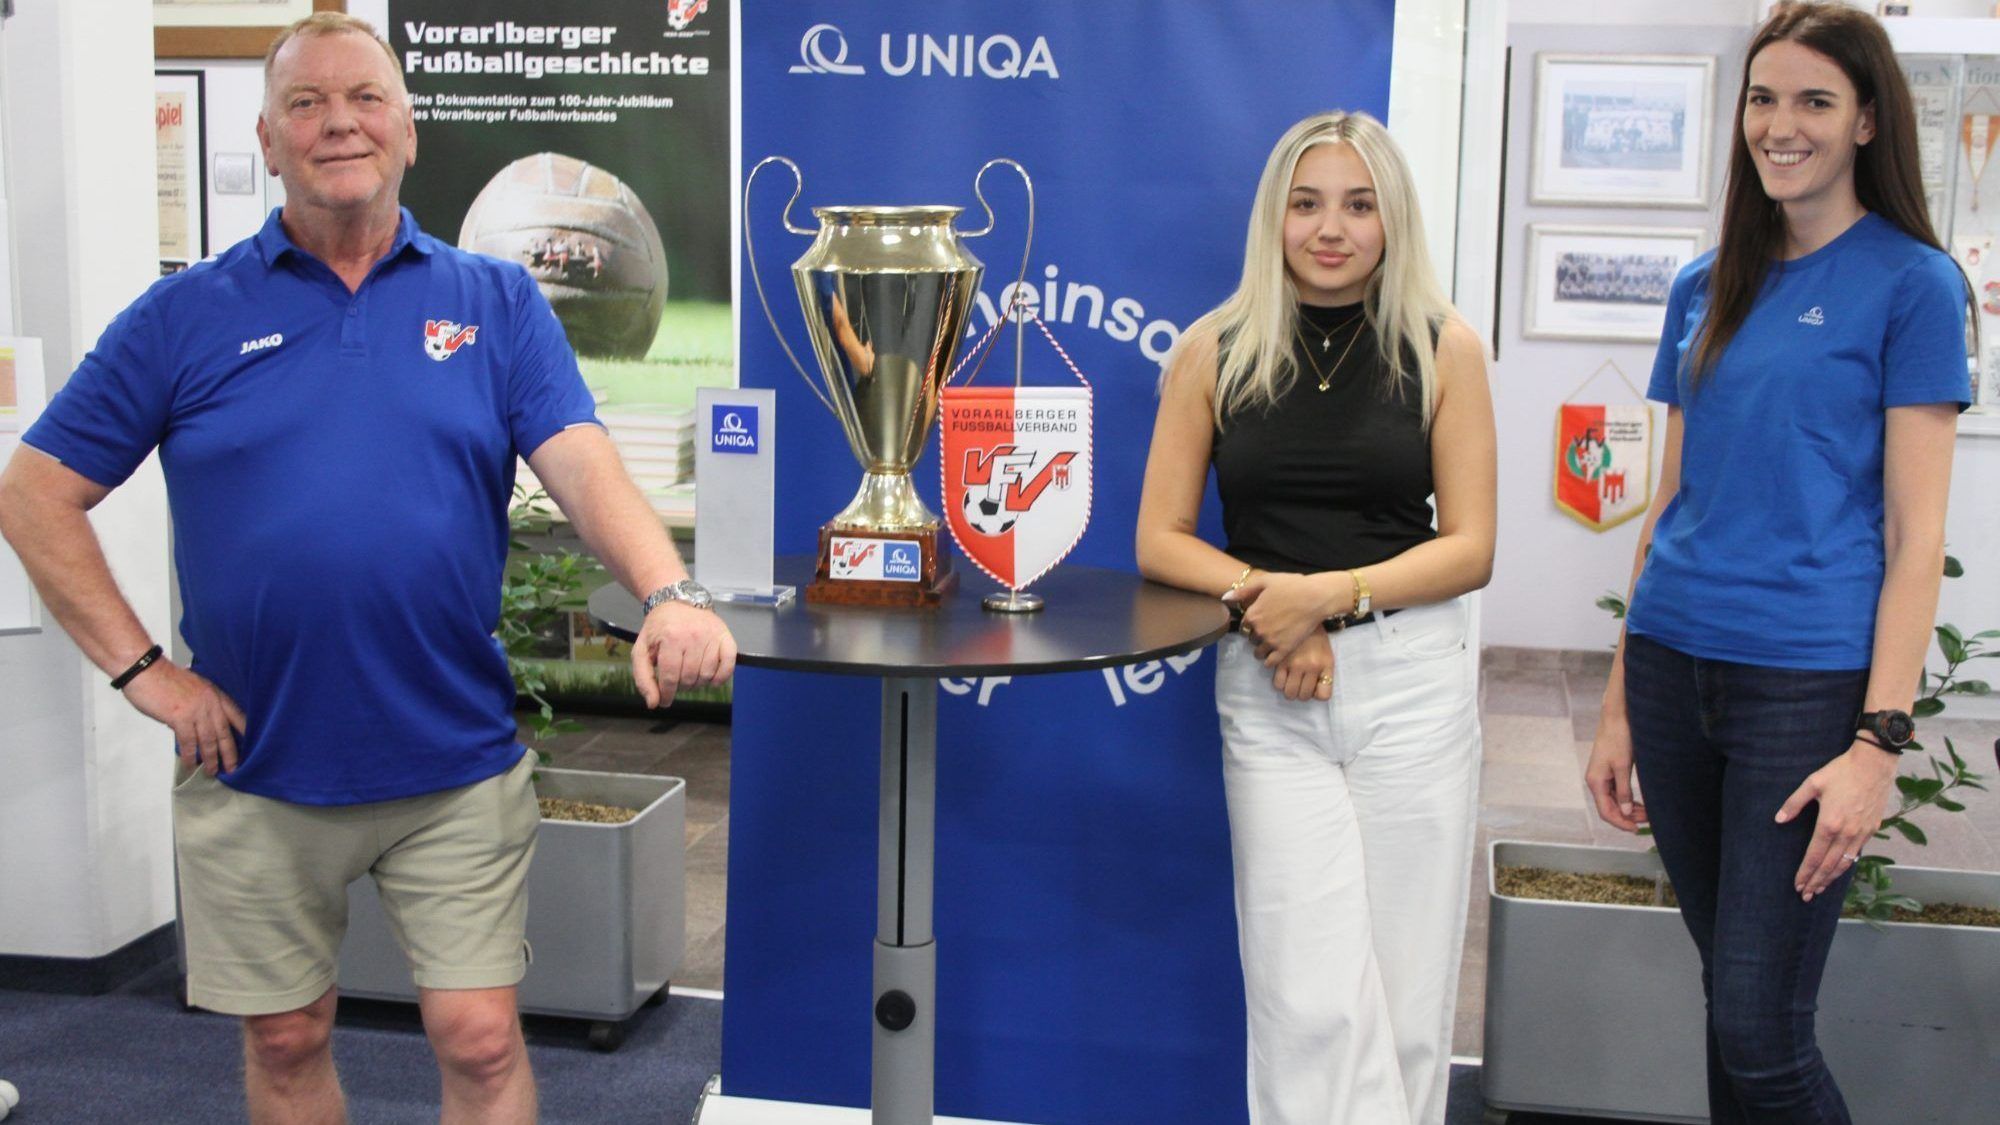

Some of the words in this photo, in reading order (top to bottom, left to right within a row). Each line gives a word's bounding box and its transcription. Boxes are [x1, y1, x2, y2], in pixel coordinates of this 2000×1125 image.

[404, 21, 617, 49] Vorarlberger
[880, 33, 1060, 79] UNIQA
[405, 51, 709, 79] Fußballgeschichte
[436, 93, 527, 106] Dokumentation
[530, 96, 555, 107] zum
[560, 94, 673, 109] 100-Jahr-Jubiläum
[156, 102, 182, 129] piel
[431, 108, 505, 123] Vorarlberger
[510, 109, 617, 123] Fußballverbandes
[240, 333, 283, 355] JAKO
[952, 408, 1077, 420] VORARLBERGER
[952, 421, 1078, 433] FUSSBALLVERBAND
[715, 434, 755, 448] UNIQA
[885, 564, 917, 575] UNIQA
